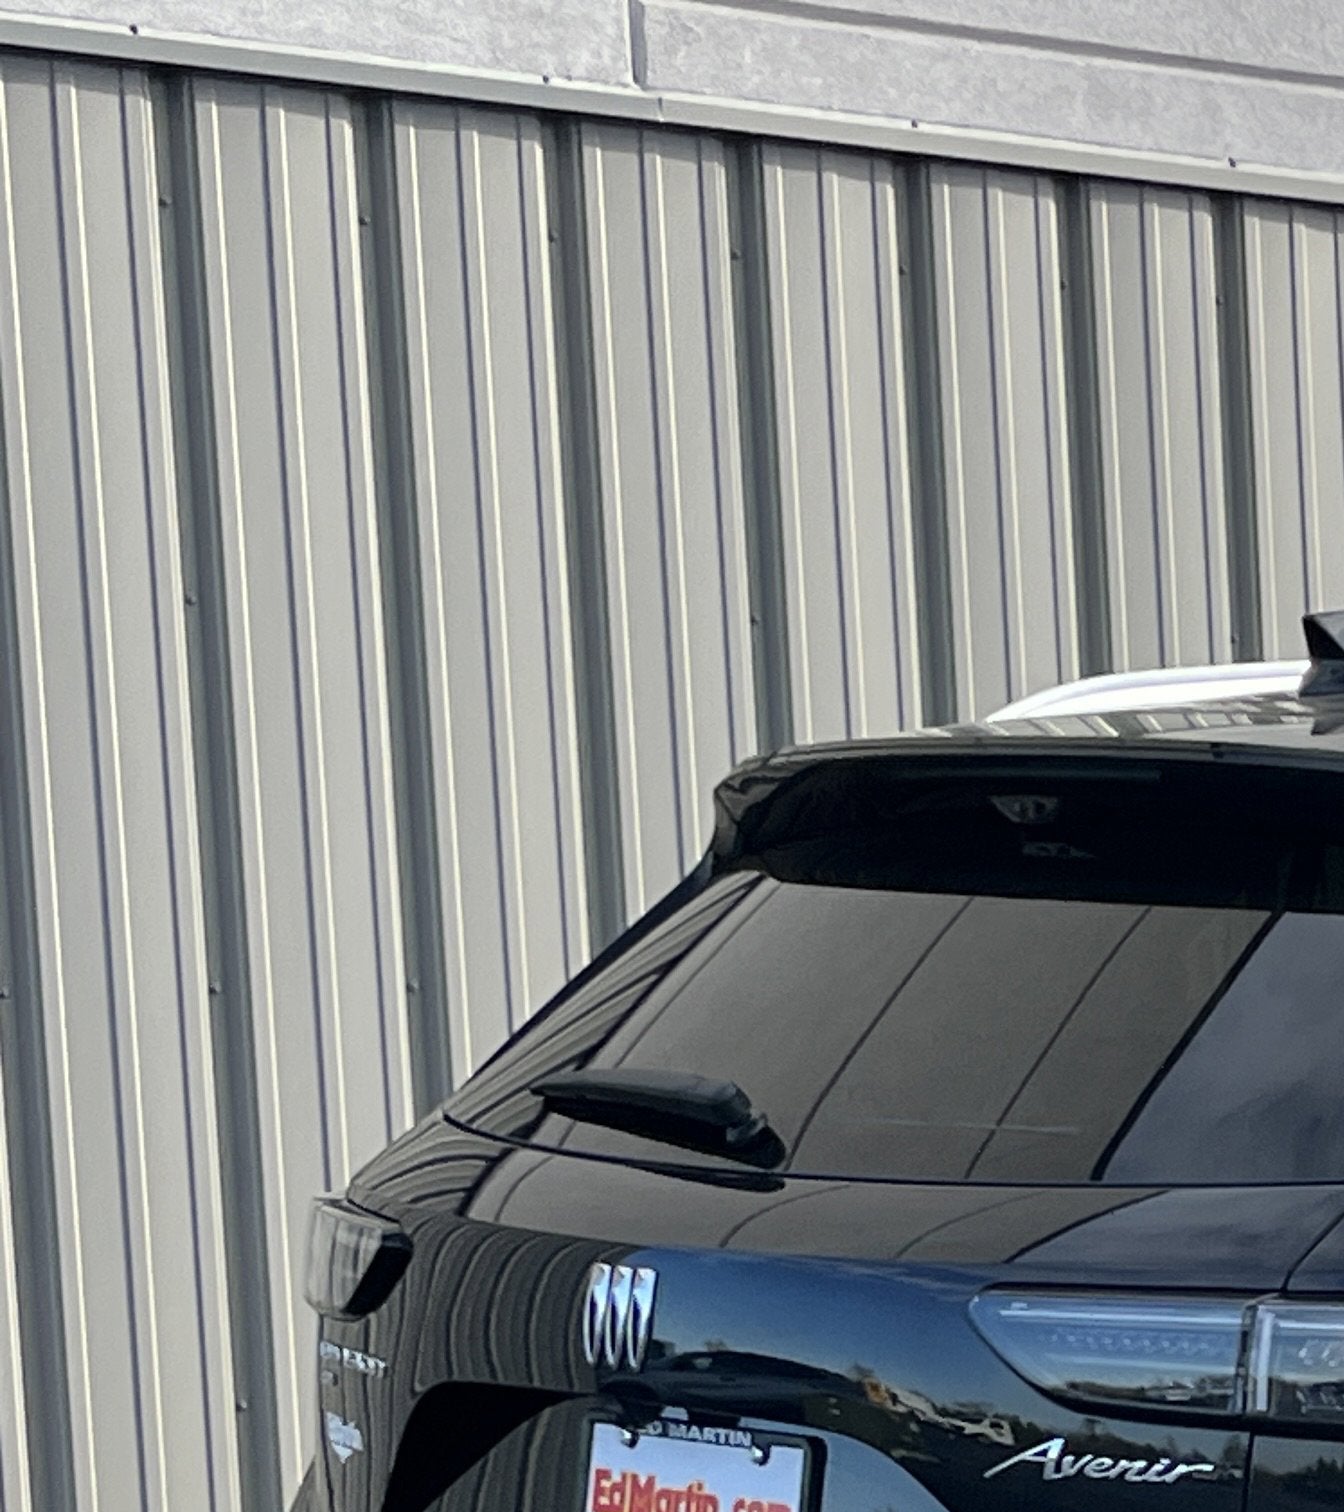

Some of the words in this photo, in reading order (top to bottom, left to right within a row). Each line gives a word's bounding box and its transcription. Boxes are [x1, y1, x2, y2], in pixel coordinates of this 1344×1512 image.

[639, 1420, 663, 1436] D
[667, 1421, 753, 1447] MARTIN
[983, 1438, 1215, 1484] Avenir
